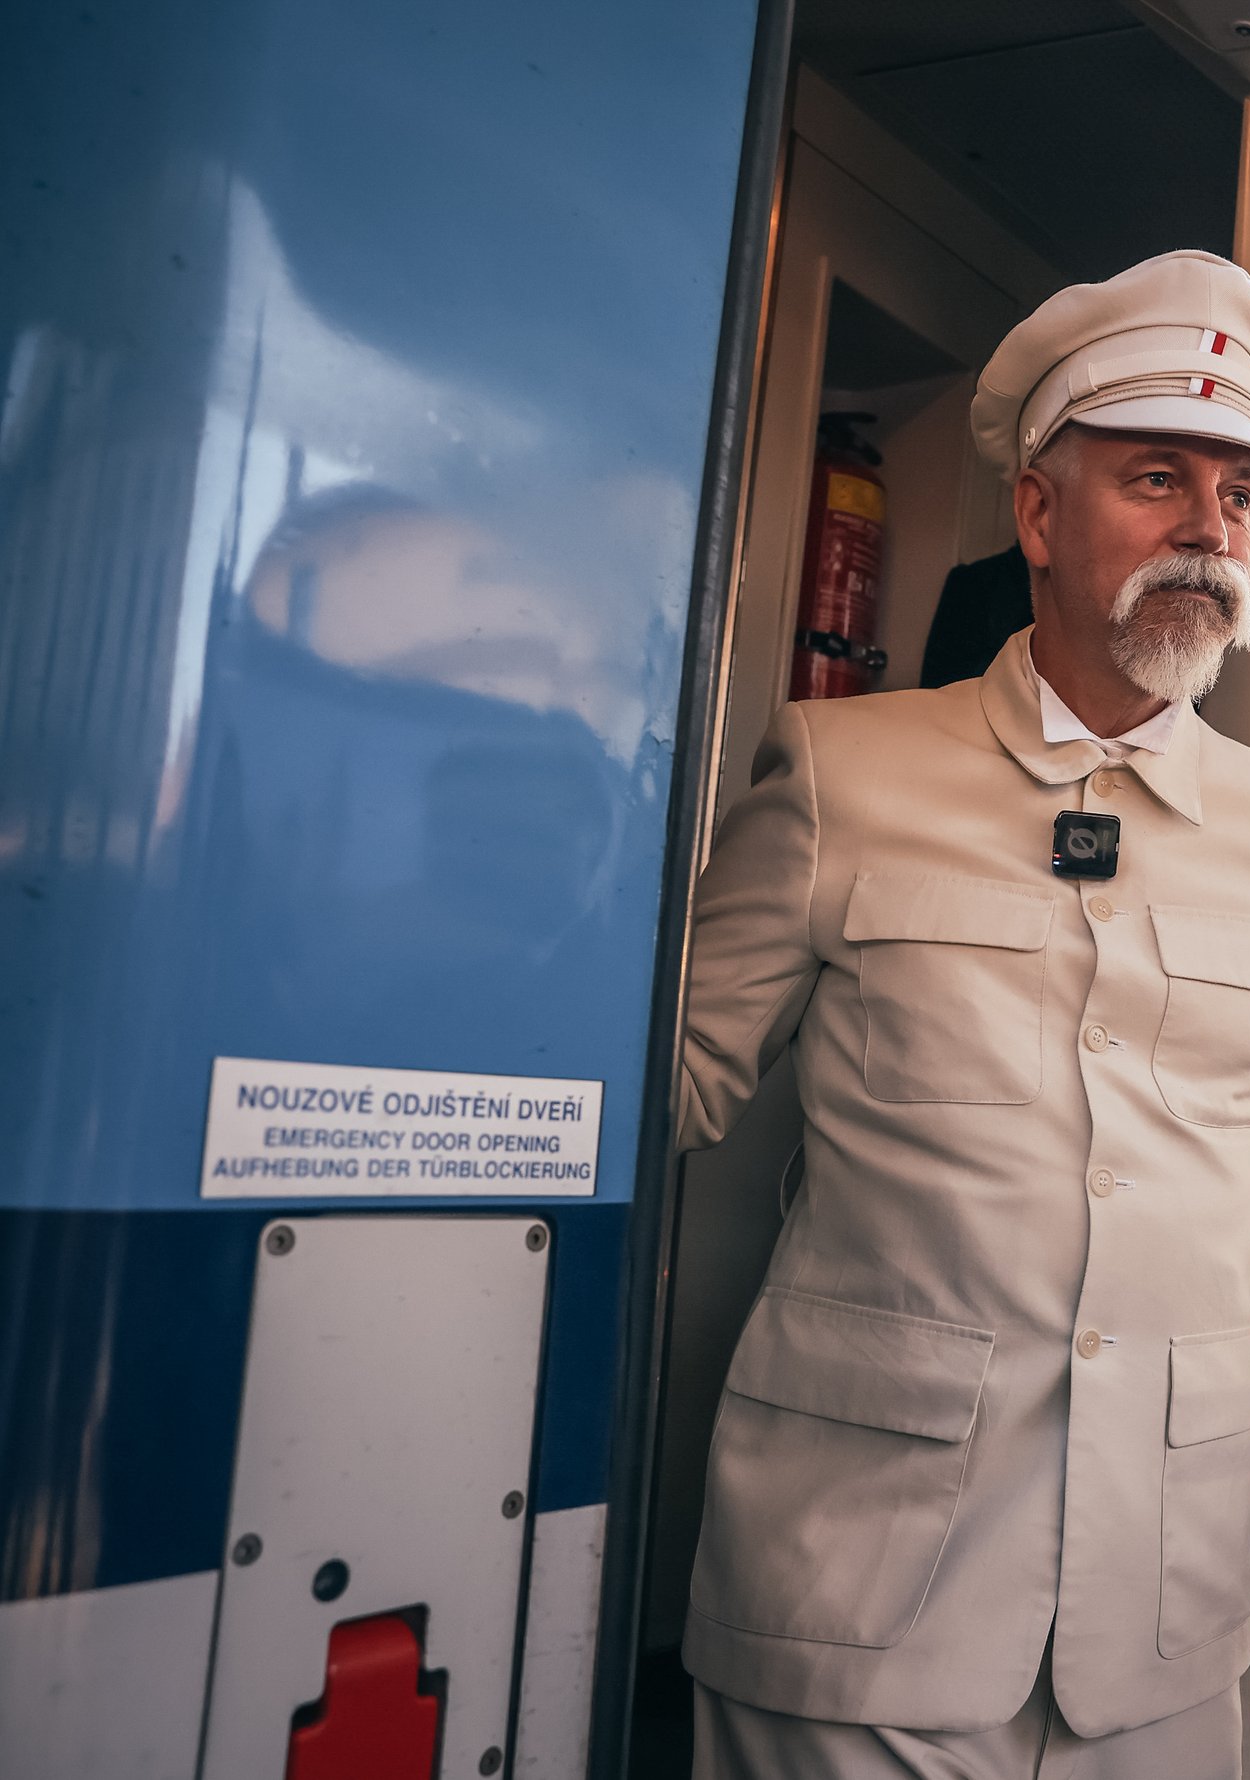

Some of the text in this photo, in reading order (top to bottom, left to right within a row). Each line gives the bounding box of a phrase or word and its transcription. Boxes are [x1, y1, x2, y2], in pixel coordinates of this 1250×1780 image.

[237, 1083, 584, 1122] NOUZOVÉ ODJIŠTĚNÍ DVEŘÍ
[263, 1127, 560, 1153] EMERGENCY DOOR OPENING
[212, 1155, 591, 1180] AUFHEBUNG DER TÜRBLOCKIERUNG
